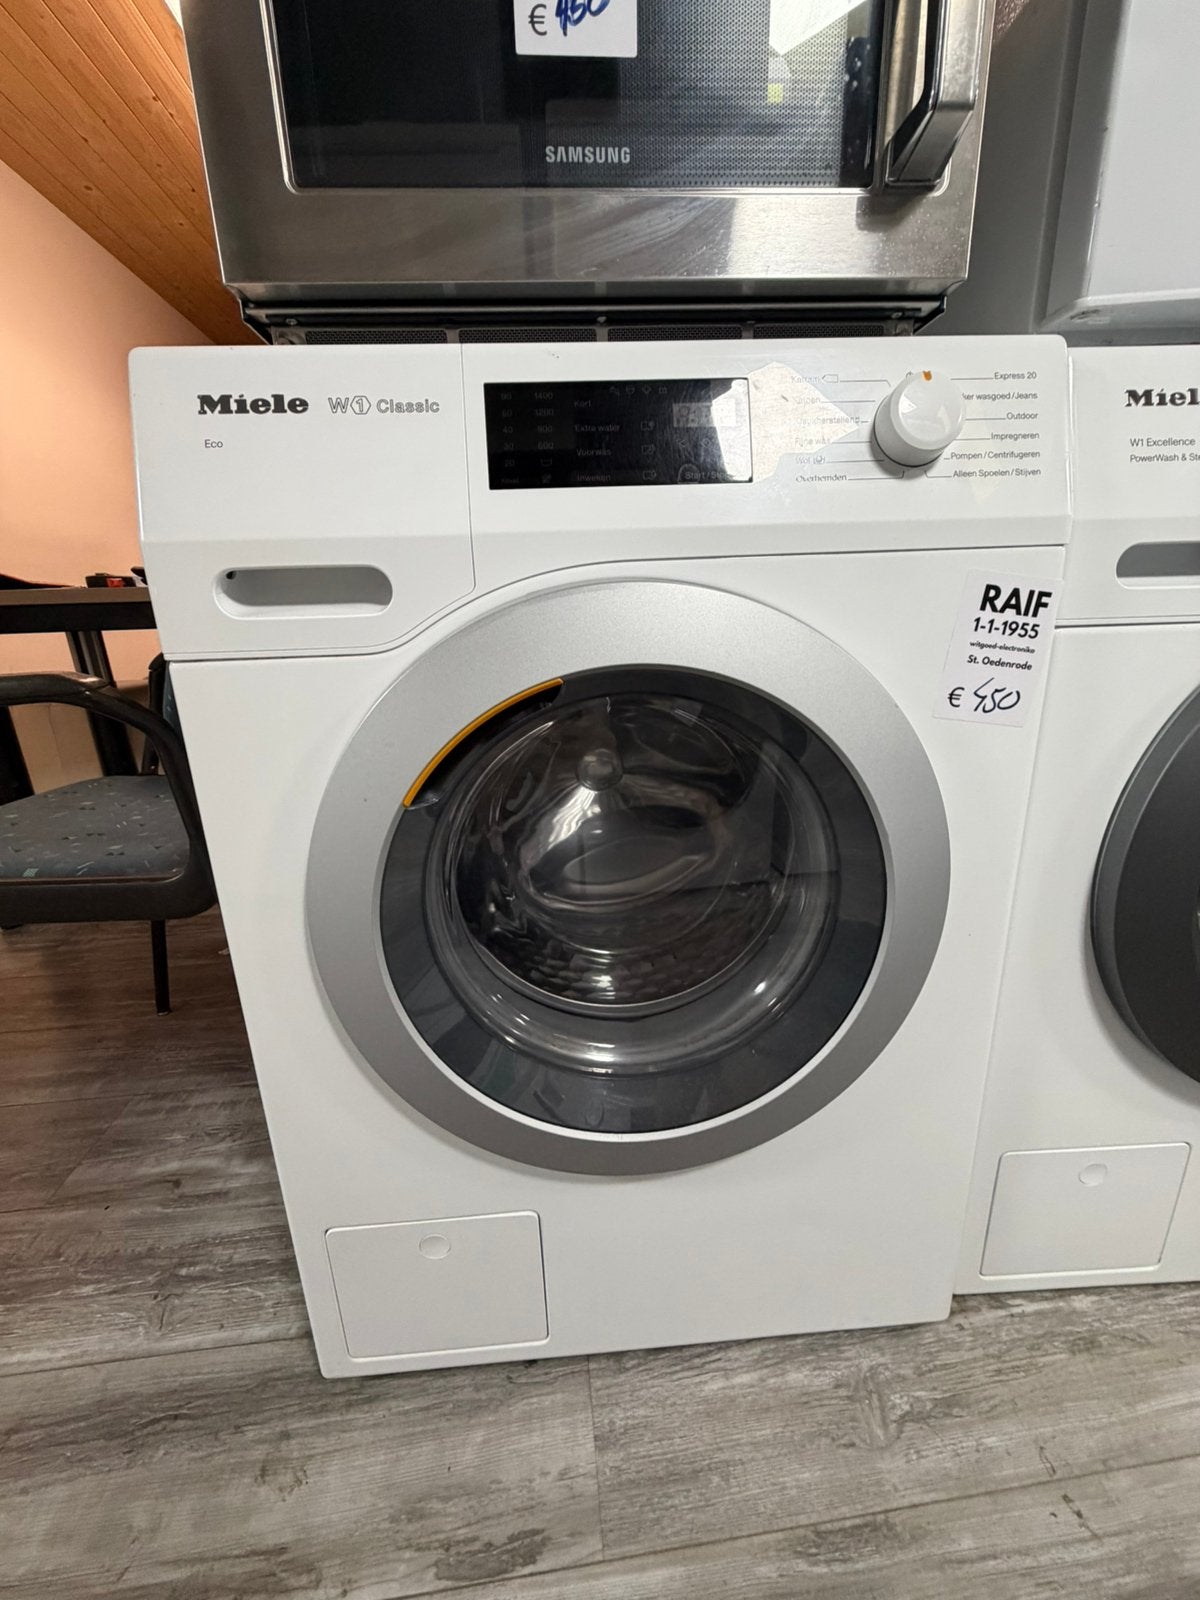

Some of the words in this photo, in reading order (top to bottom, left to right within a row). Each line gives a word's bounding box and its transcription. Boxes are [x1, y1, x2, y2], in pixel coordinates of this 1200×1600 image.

[528, 4, 547, 36] €
[545, 146, 630, 163] SAMSUNG
[994, 371, 1025, 380] Express
[1026, 371, 1037, 379] 20
[197, 394, 309, 415] Miele
[376, 398, 440, 413] Classic
[1006, 411, 1038, 420] Outdoor
[991, 432, 1040, 441] Impregneren
[1130, 438, 1144, 447] W1
[1146, 437, 1196, 447] Excellence
[204, 439, 224, 449] Eco
[1129, 453, 1179, 463] PowerWash
[1180, 453, 1187, 462] &
[953, 470, 977, 478] Alleen
[980, 584, 1053, 618] RAIF
[973, 617, 1040, 639] 1-1-1955
[967, 655, 979, 664] St.
[981, 656, 1032, 670] Oedenrode
[947, 686, 965, 708] €
[973, 677, 1021, 713] 450
